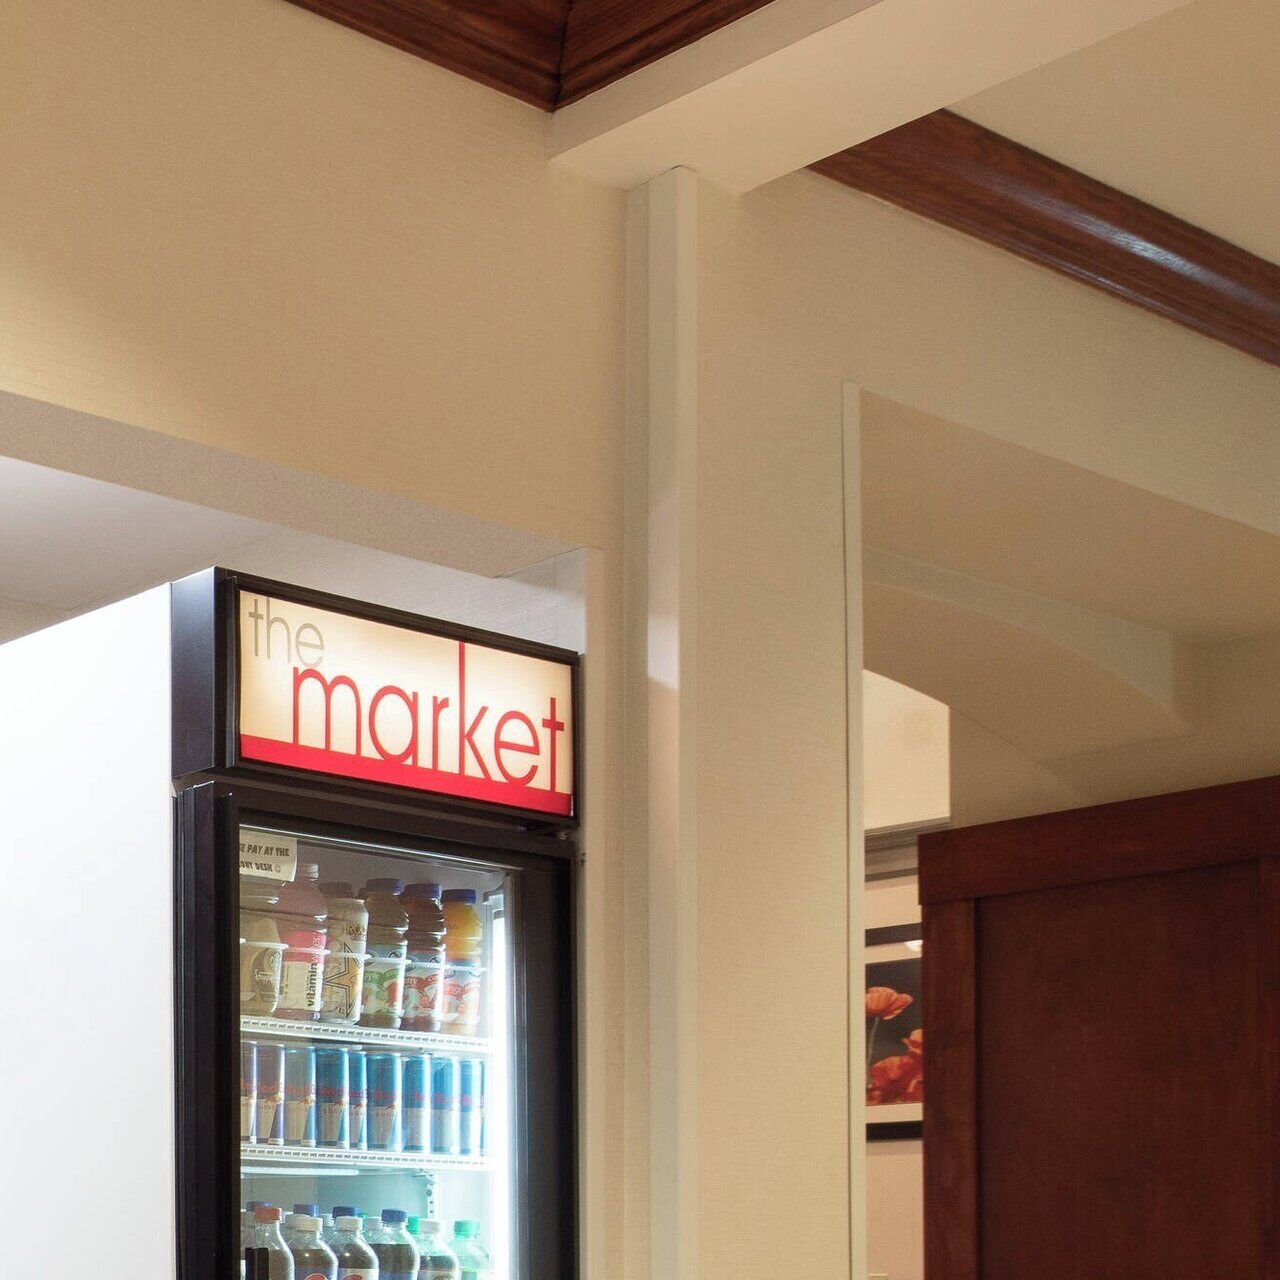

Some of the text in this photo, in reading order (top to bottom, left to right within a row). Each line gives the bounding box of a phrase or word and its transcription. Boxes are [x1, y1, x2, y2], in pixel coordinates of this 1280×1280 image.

[249, 597, 324, 667] the
[293, 641, 565, 791] market
[275, 847, 290, 858] THE
